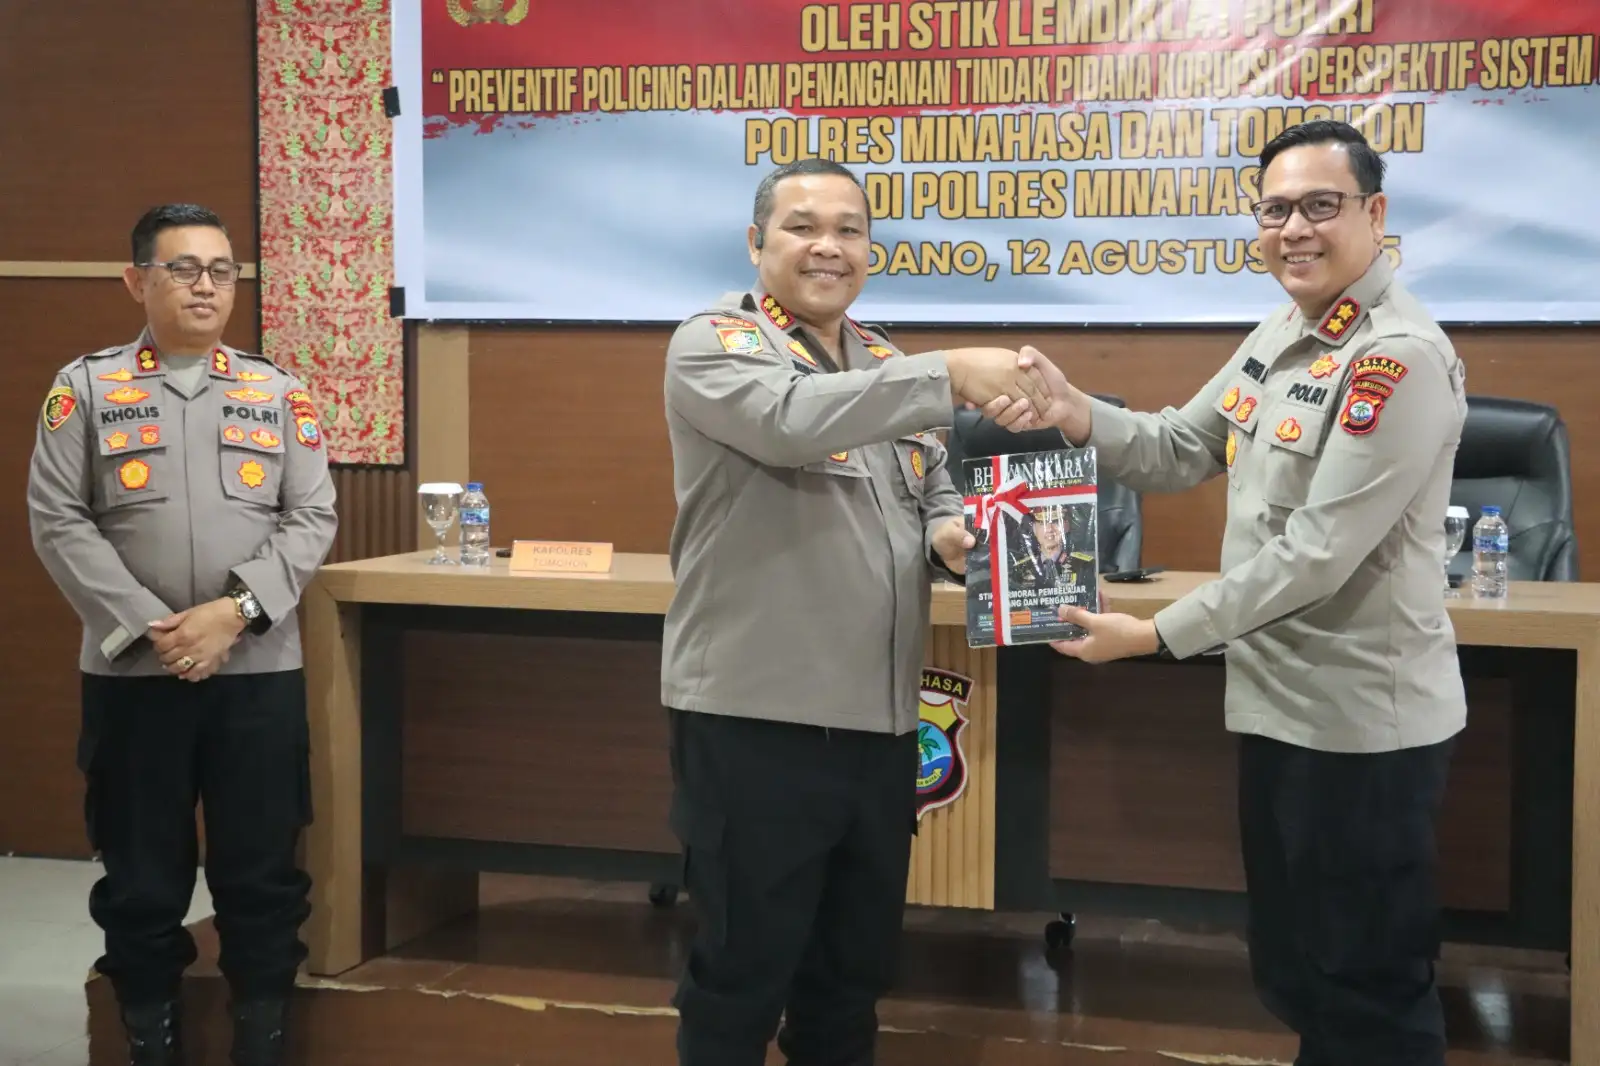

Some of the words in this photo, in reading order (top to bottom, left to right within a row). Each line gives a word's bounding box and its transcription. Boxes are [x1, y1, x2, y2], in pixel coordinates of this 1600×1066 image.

[801, 3, 900, 52] OLEH
[908, 0, 1000, 50] STIK
[448, 67, 579, 114] PREVENTIF
[582, 63, 692, 112] POLICING
[697, 63, 781, 109] DALAM
[785, 59, 951, 108] PENANGANAN
[956, 55, 1050, 105] TINDAK
[1055, 52, 1153, 102] PIDANA
[1157, 47, 1278, 100] KORUPSI
[1480, 34, 1594, 90] SISTEM
[745, 116, 895, 165] POLRES
[901, 108, 1111, 163] MINAHASA
[1119, 105, 1205, 160] DAN
[865, 172, 904, 220] DI
[912, 168, 1066, 220] POLRES
[1074, 166, 1261, 218] MINAHAS
[1007, 240, 1051, 275] 12
[1058, 238, 1269, 275] AGUSTUS
[1355, 358, 1403, 373] POLRES
[1287, 382, 1328, 406] POLRI
[100, 406, 160, 425] KHOLIS
[222, 405, 279, 425] POLRI
[533, 545, 592, 556] KAPOLRES
[1023, 598, 1038, 606] DAN
[1041, 595, 1077, 605] PENGABDI
[920, 676, 964, 696] HASA
